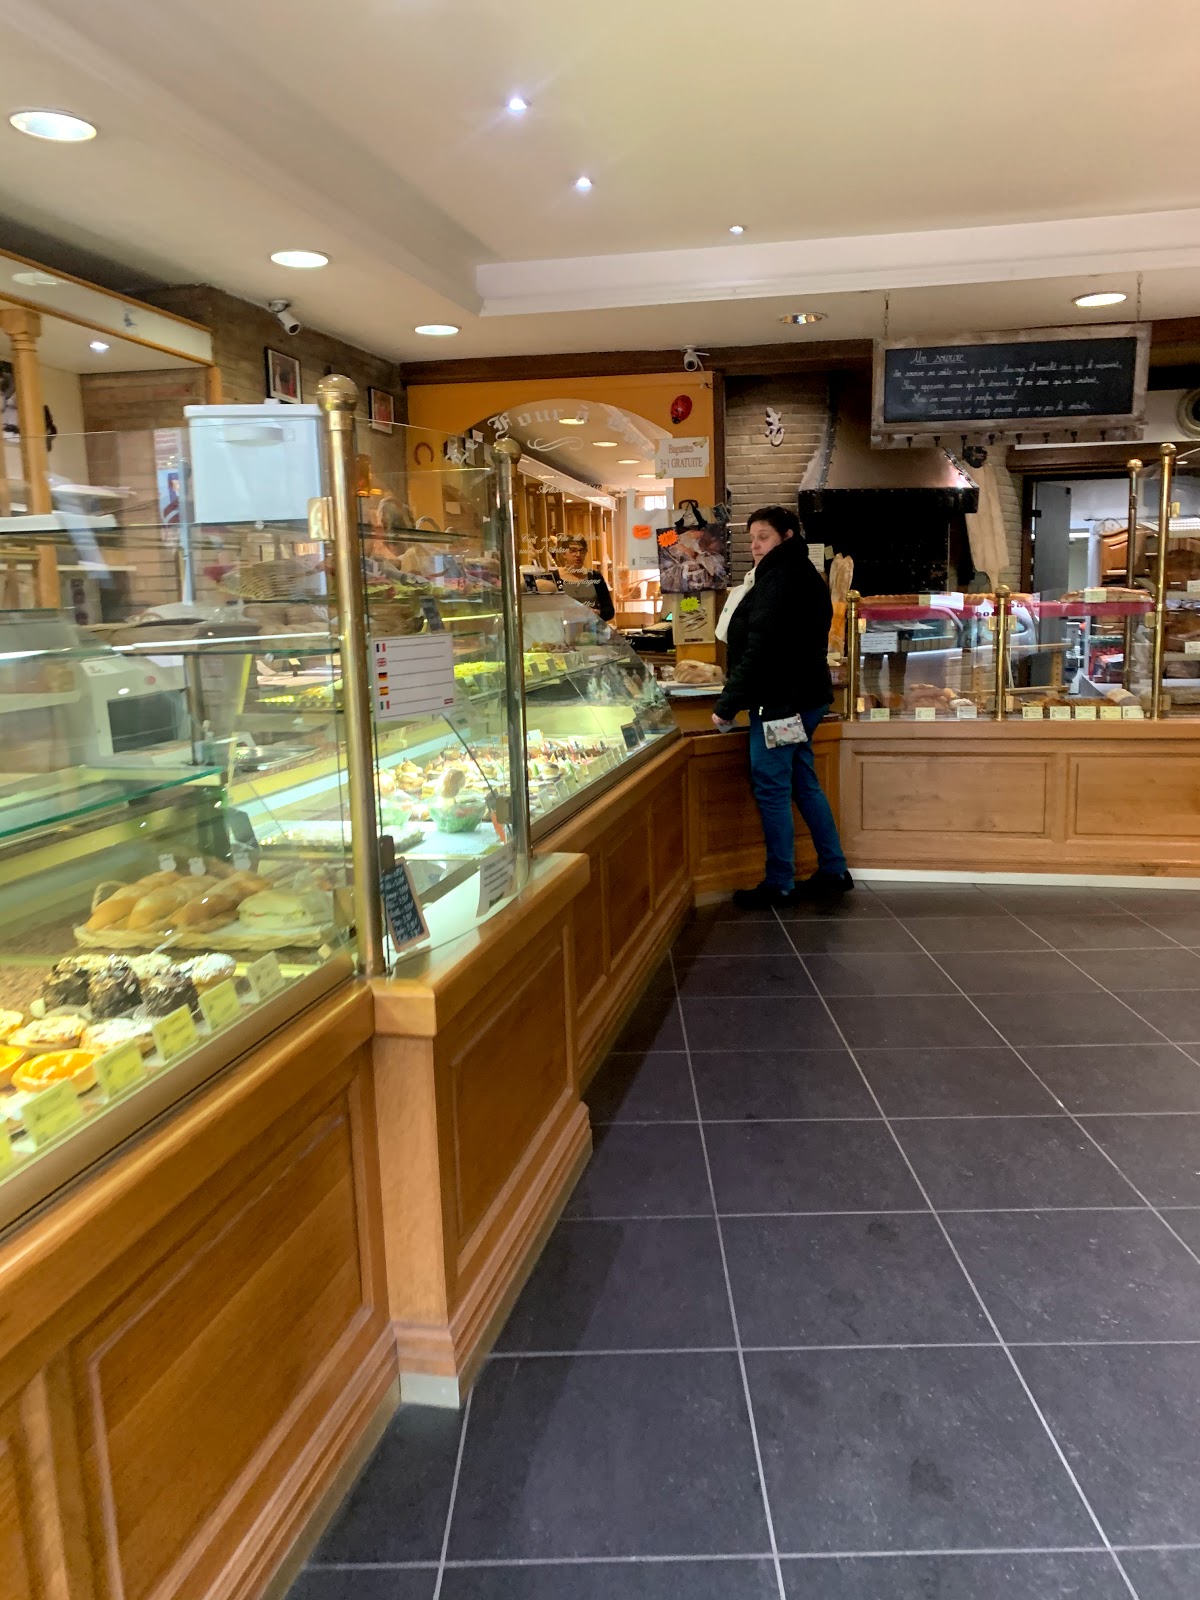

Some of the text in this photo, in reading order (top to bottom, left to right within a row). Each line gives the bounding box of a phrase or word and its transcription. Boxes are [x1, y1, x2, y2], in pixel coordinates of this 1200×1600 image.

[910, 350, 926, 364] Un
[668, 444, 694, 456] Baguettes
[671, 457, 703, 468] GRATUITE
